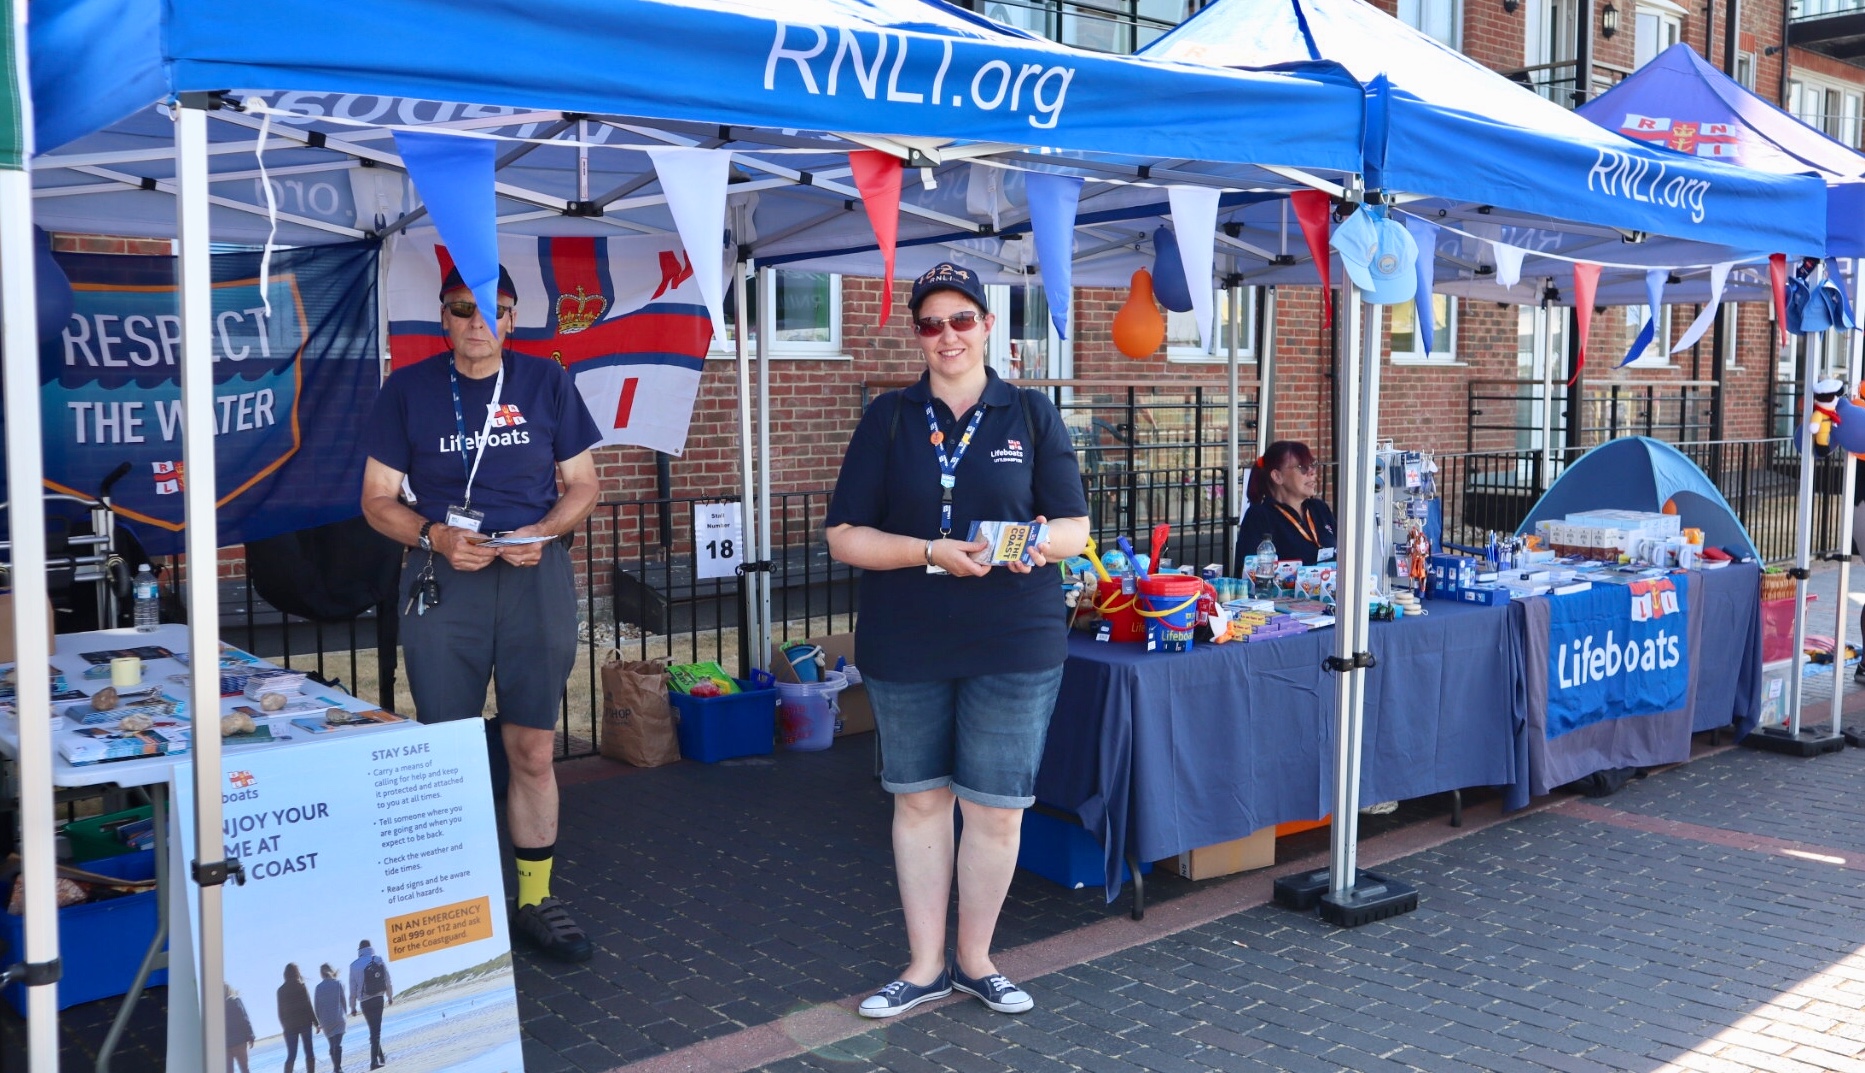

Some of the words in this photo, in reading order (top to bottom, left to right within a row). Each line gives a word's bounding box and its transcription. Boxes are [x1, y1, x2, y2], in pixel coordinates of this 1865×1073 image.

[764, 21, 1075, 128] RNLI.org
[1638, 118, 1656, 129] R
[1710, 124, 1727, 134] N
[1588, 150, 1711, 223] RNLI.org
[62, 307, 271, 367] RESPCT
[68, 402, 145, 444] THE
[991, 449, 1023, 458] Lifeboats
[159, 464, 168, 472] R
[164, 484, 172, 493] L
[1003, 528, 1018, 560] COAST
[1016, 528, 1026, 540] ON
[706, 539, 734, 559] 18
[1010, 543, 1022, 560] THE
[1558, 628, 1680, 689] Lifeboats
[372, 747, 400, 761] STAY
[403, 743, 430, 756] SAFE
[374, 766, 393, 777] Carry
[401, 763, 424, 772] means
[375, 777, 398, 787] calling
[400, 774, 410, 783] for
[411, 771, 427, 781] help
[429, 769, 441, 778] and
[443, 767, 459, 776] keep
[376, 790, 382, 798] it
[383, 784, 417, 798] protected
[419, 782, 432, 791] and
[434, 776, 464, 787] attached
[387, 800, 400, 809] you
[402, 797, 409, 805] at
[411, 794, 420, 803] all
[222, 812, 267, 838] NJOY
[272, 802, 329, 826] YOUR
[379, 817, 392, 826] Tell
[394, 812, 426, 824] someone
[427, 807, 449, 817] where
[450, 805, 463, 815] you
[381, 829, 392, 837] are
[394, 825, 413, 837] going
[415, 822, 427, 831] and
[429, 818, 448, 828] when
[449, 816, 462, 826] you
[223, 840, 252, 859] ME
[257, 835, 281, 854] AT
[382, 838, 405, 848] expect
[407, 835, 415, 843] to
[416, 832, 425, 841] be
[384, 854, 405, 865] Check
[407, 851, 419, 859] the
[420, 846, 449, 858] weather
[450, 842, 463, 851] and
[251, 852, 318, 880] COAST
[385, 867, 399, 876] tide
[387, 883, 404, 893] Read
[406, 880, 424, 891] signs
[426, 876, 438, 885] and
[440, 874, 449, 882] be
[450, 870, 471, 880] aware
[388, 896, 396, 904] of
[398, 893, 414, 903] local
[391, 923, 403, 933] IN
[406, 920, 420, 930] AN
[423, 904, 481, 926] EMERGENCY
[393, 934, 406, 944] call
[409, 930, 425, 940] 999
[427, 928, 435, 936] or
[438, 924, 450, 933] 112
[453, 920, 467, 930] and
[469, 917, 480, 925] ask
[394, 946, 405, 955] for
[408, 942, 420, 952] the
